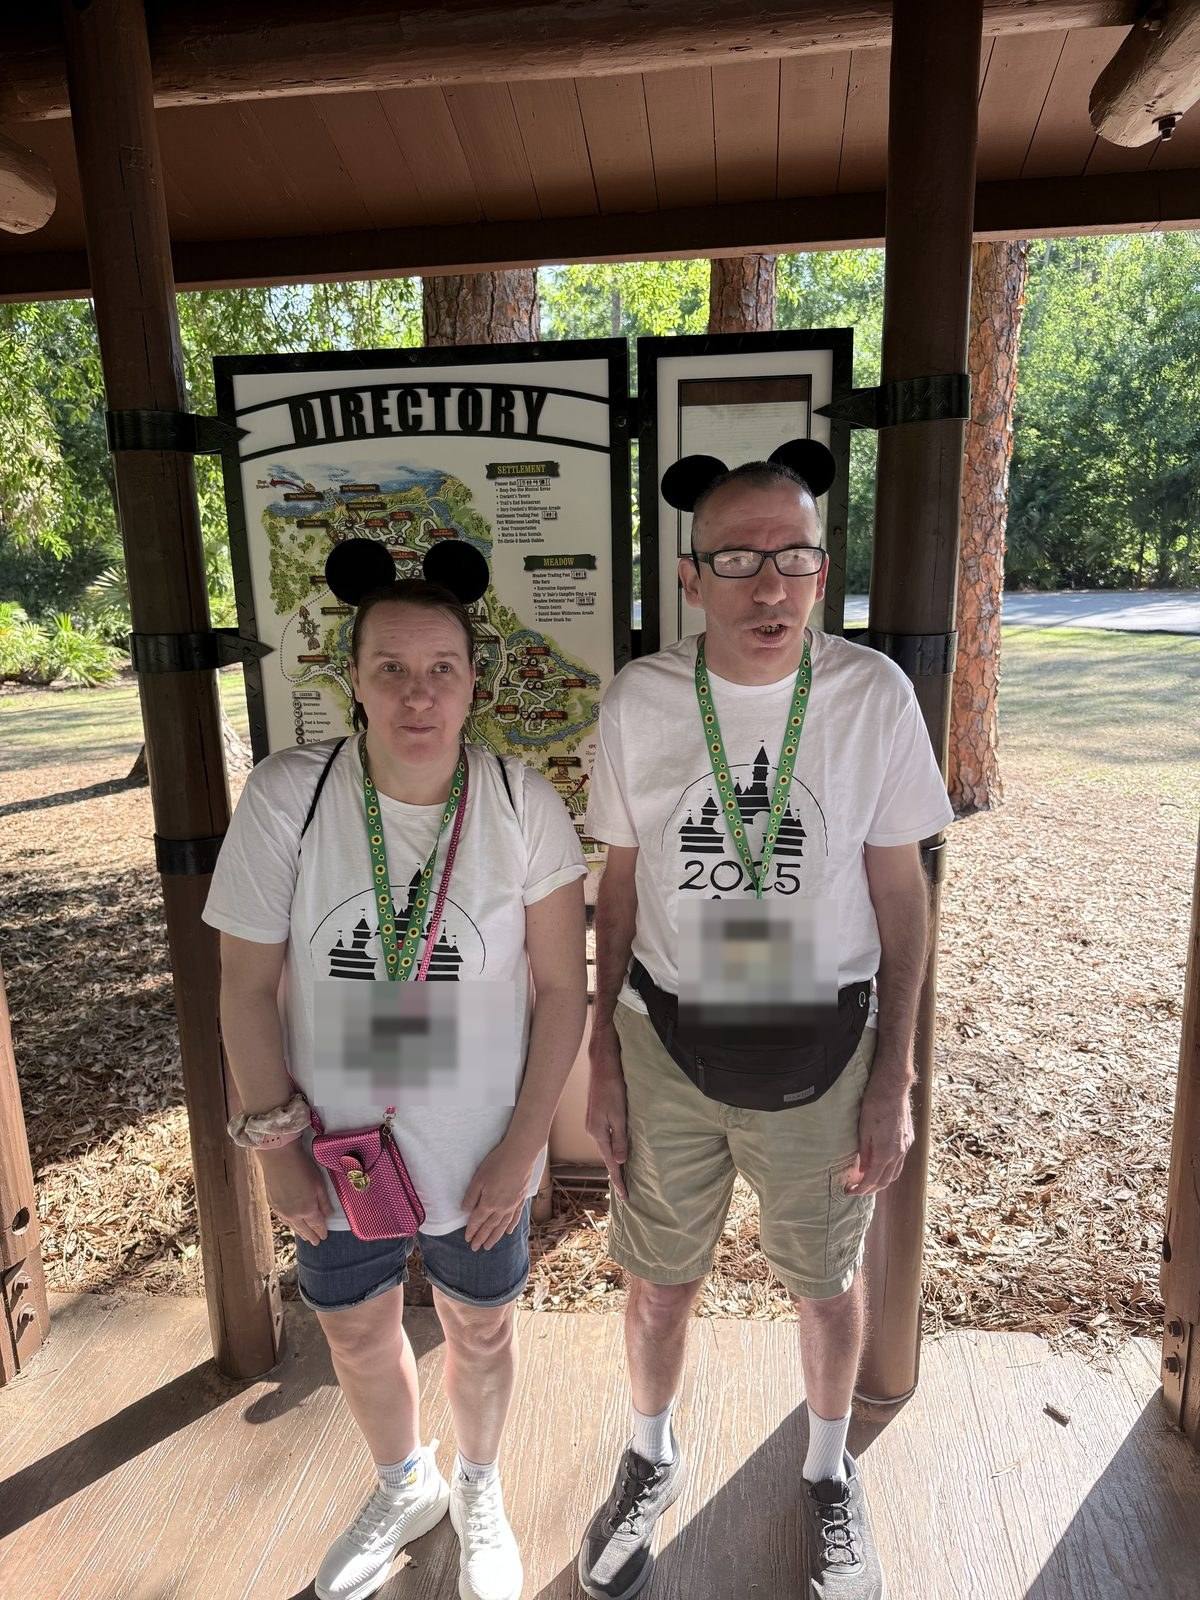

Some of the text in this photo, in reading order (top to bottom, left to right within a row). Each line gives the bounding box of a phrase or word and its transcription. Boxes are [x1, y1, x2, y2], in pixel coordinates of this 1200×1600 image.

[288, 387, 548, 443] DIRECTORY
[498, 465, 546, 474] SETTLEMENT
[544, 558, 574, 566] MEADOW
